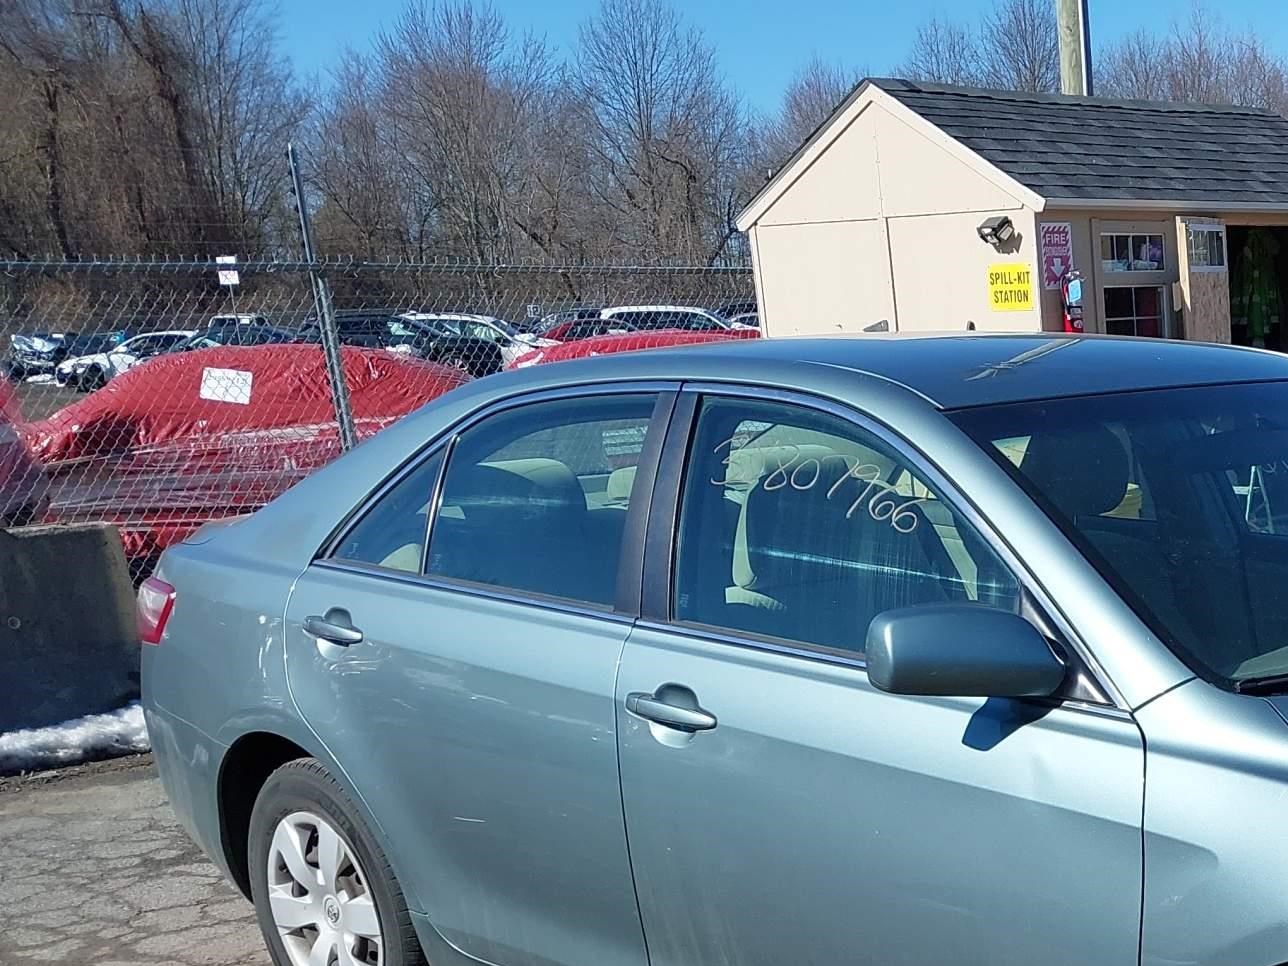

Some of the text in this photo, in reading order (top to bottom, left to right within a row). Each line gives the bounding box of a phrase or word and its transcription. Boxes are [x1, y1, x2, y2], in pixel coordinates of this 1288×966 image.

[1045, 233, 1066, 245] FIRE
[989, 271, 1031, 285] SPILL-KIT
[993, 290, 1029, 303] STATION
